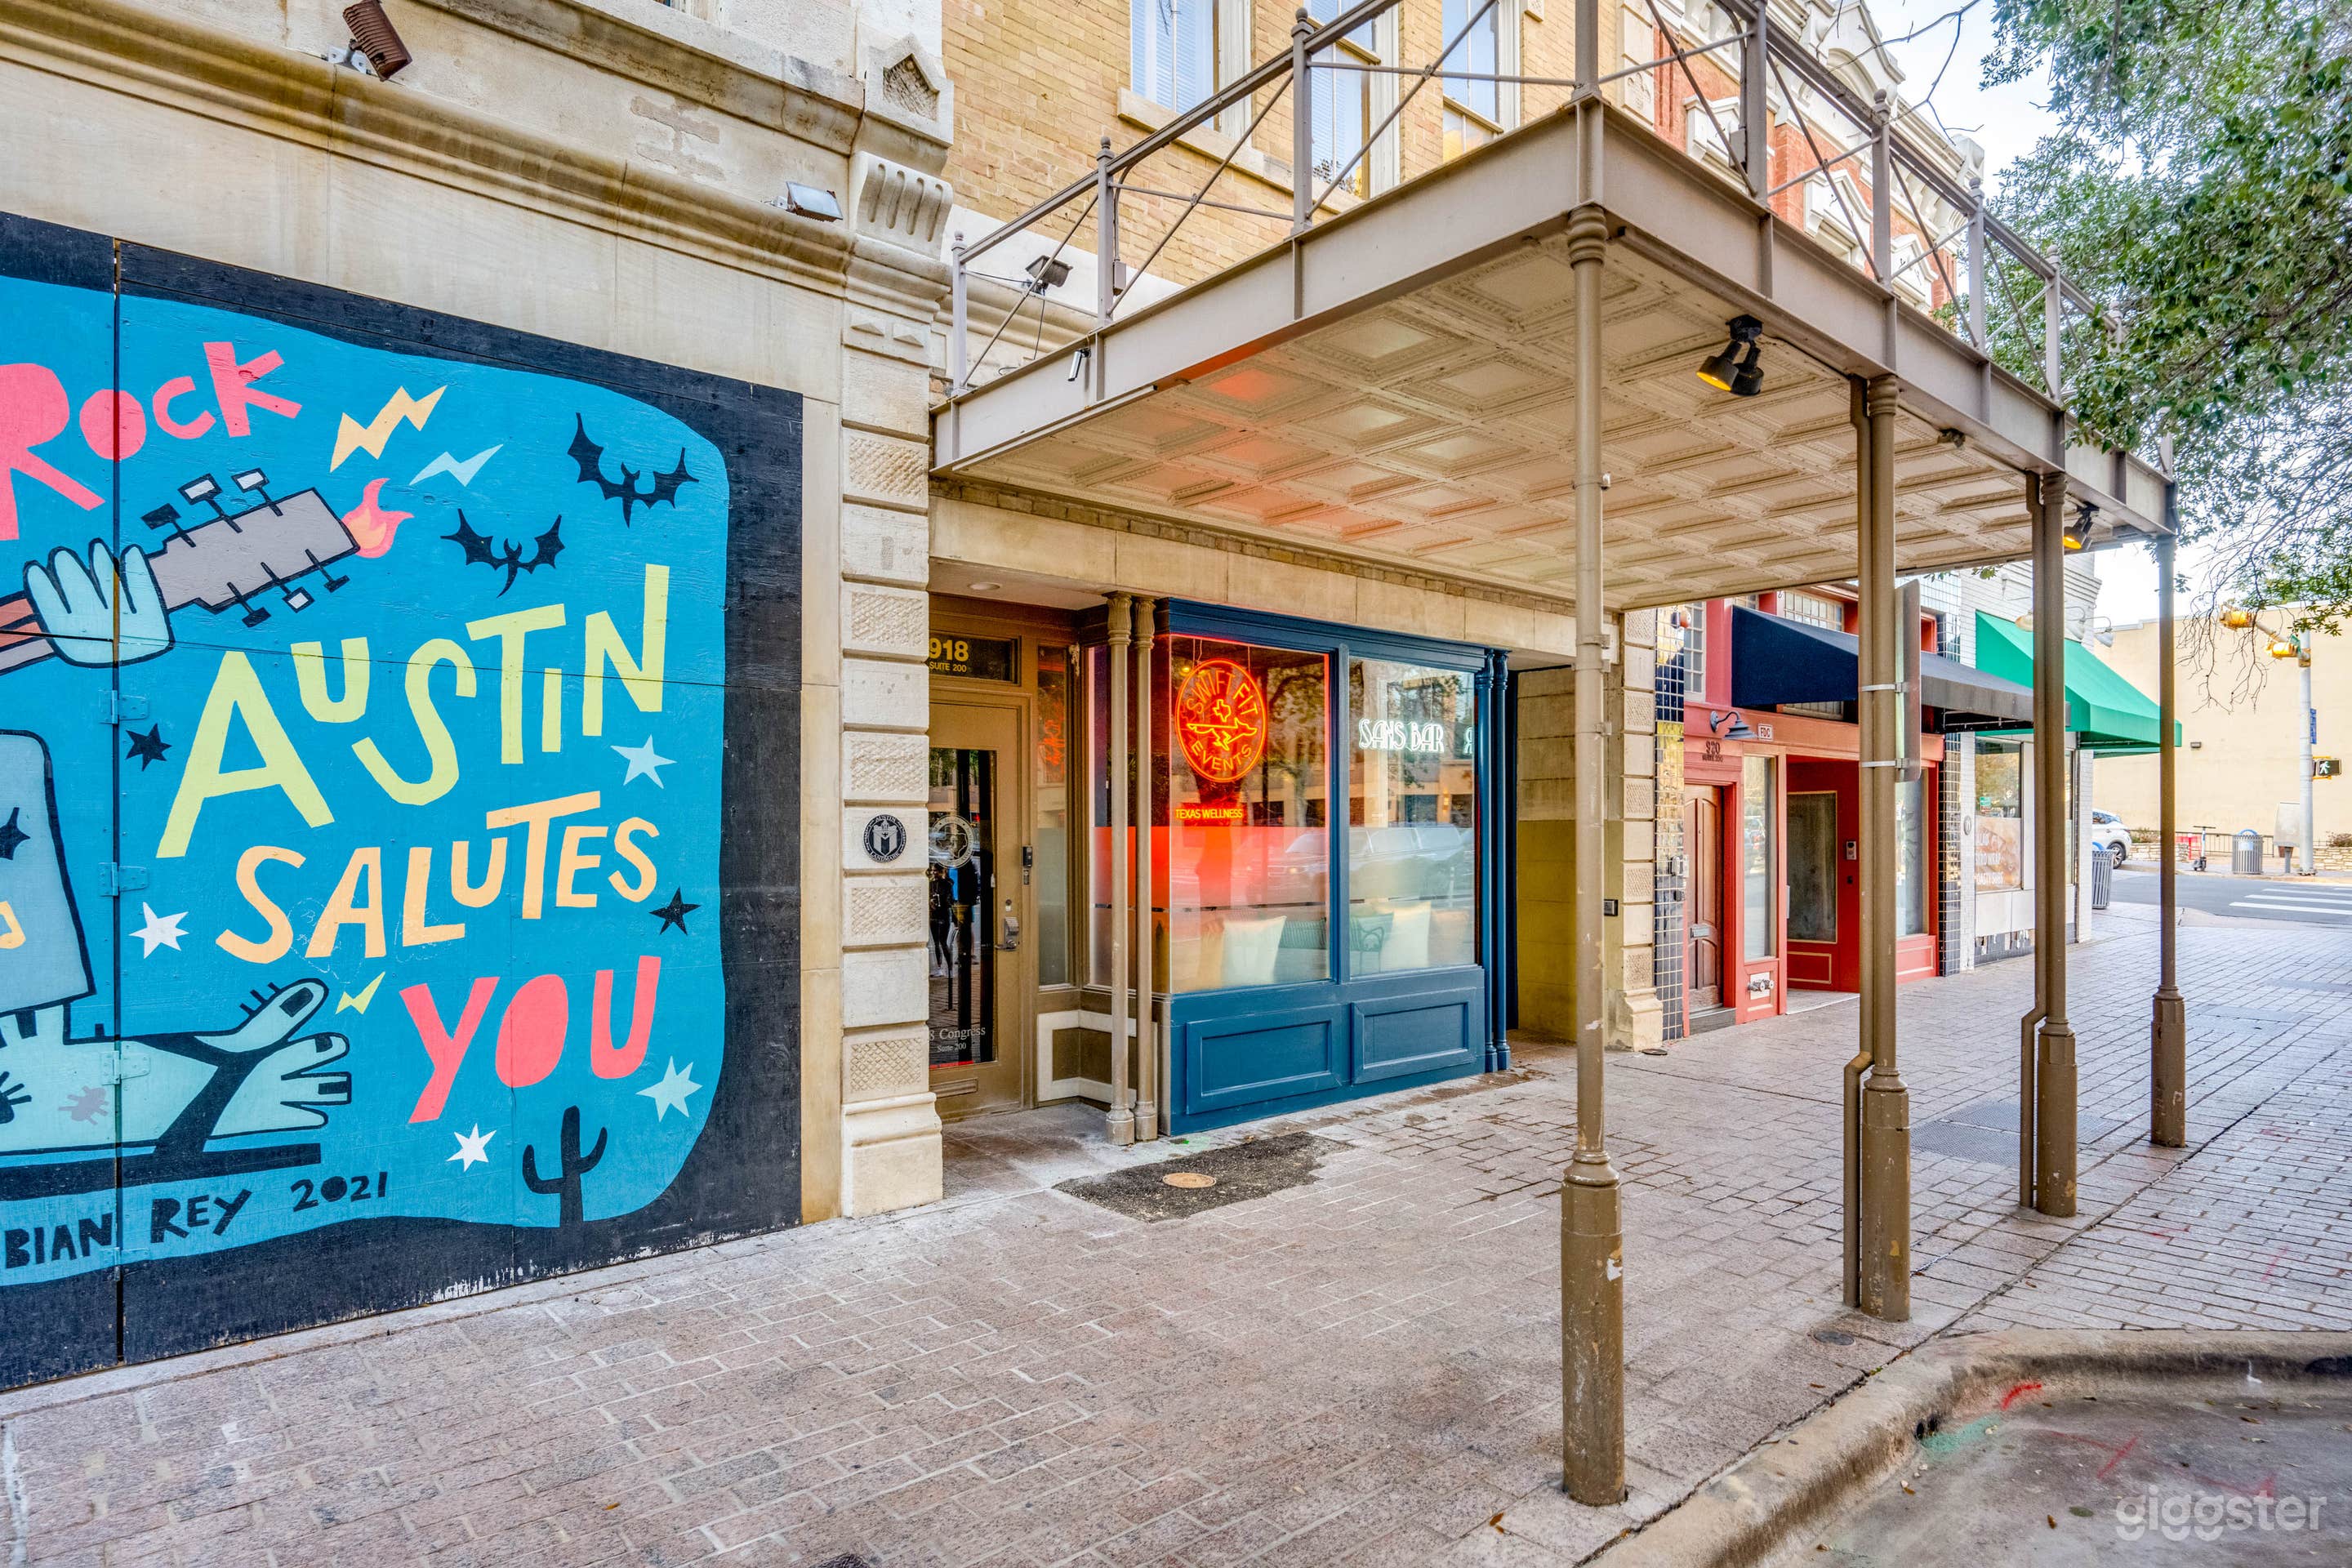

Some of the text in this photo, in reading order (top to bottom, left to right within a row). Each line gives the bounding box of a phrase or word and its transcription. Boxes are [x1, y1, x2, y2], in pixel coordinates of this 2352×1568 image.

[929, 638, 969, 662] 918
[929, 662, 967, 672] SUITE 200
[1187, 670, 1258, 715] SWIFT FIT
[157, 564, 670, 858] AUSTIN
[1359, 717, 1406, 751] SANS
[1410, 721, 1445, 753] BAR
[1191, 744, 1252, 771] EVENTS
[1176, 808, 1243, 818] TEXAS WELLNESS
[215, 791, 659, 964] SALUTES
[399, 956, 661, 1125] YOU
[939, 1027, 986, 1040] Congress
[150, 1189, 252, 1244] REY
[291, 1171, 388, 1212] 2021
